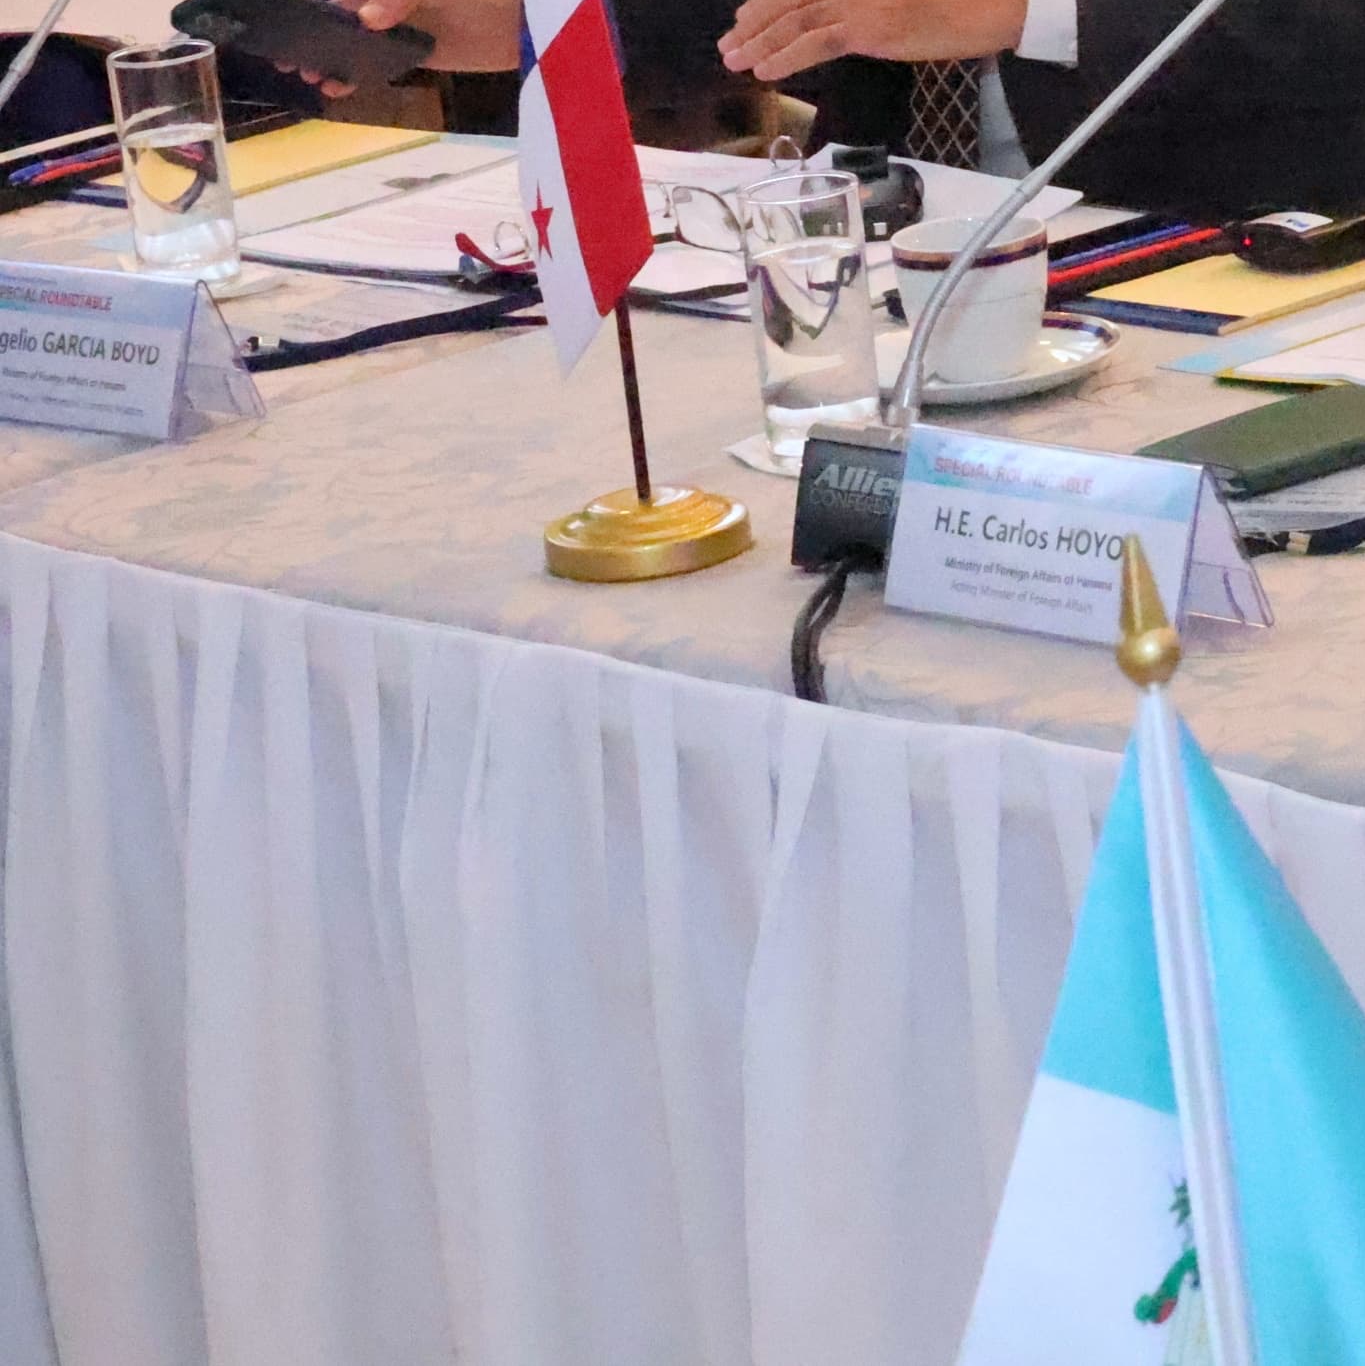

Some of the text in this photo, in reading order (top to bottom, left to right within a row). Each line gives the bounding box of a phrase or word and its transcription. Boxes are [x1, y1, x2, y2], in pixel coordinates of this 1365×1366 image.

[42, 331, 106, 360] GARCIA
[110, 341, 160, 365] BOYD
[934, 506, 1124, 561] H.E. Carlos HOYO
